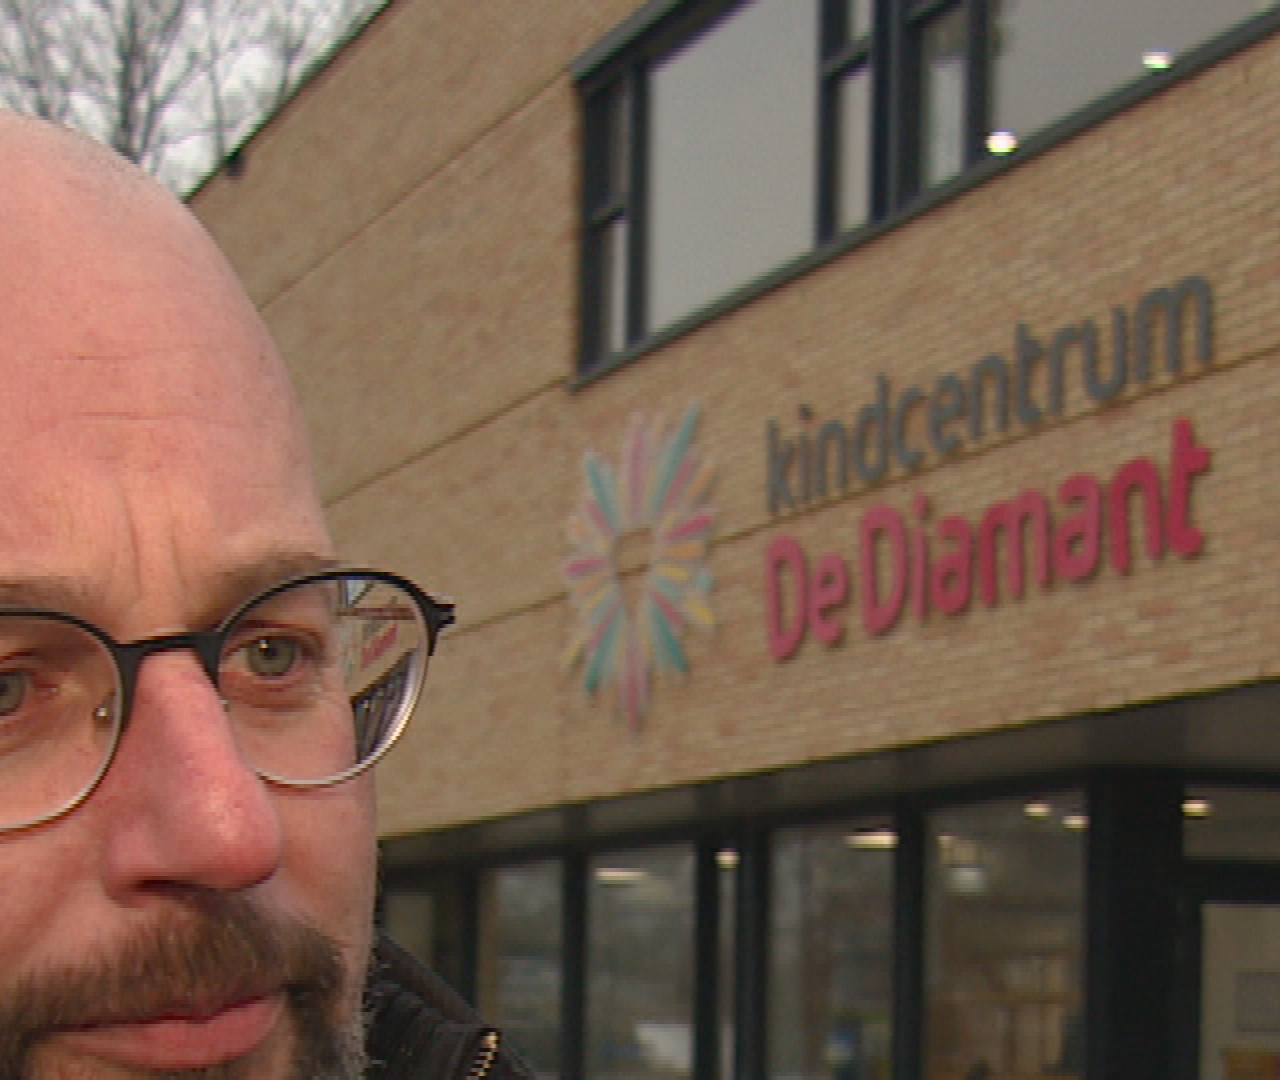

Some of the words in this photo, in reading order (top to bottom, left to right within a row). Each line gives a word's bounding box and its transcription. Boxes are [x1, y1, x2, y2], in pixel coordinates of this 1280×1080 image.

[767, 275, 1214, 513] kindcentrum
[766, 535, 848, 662] De
[860, 417, 1211, 636] Diamant
